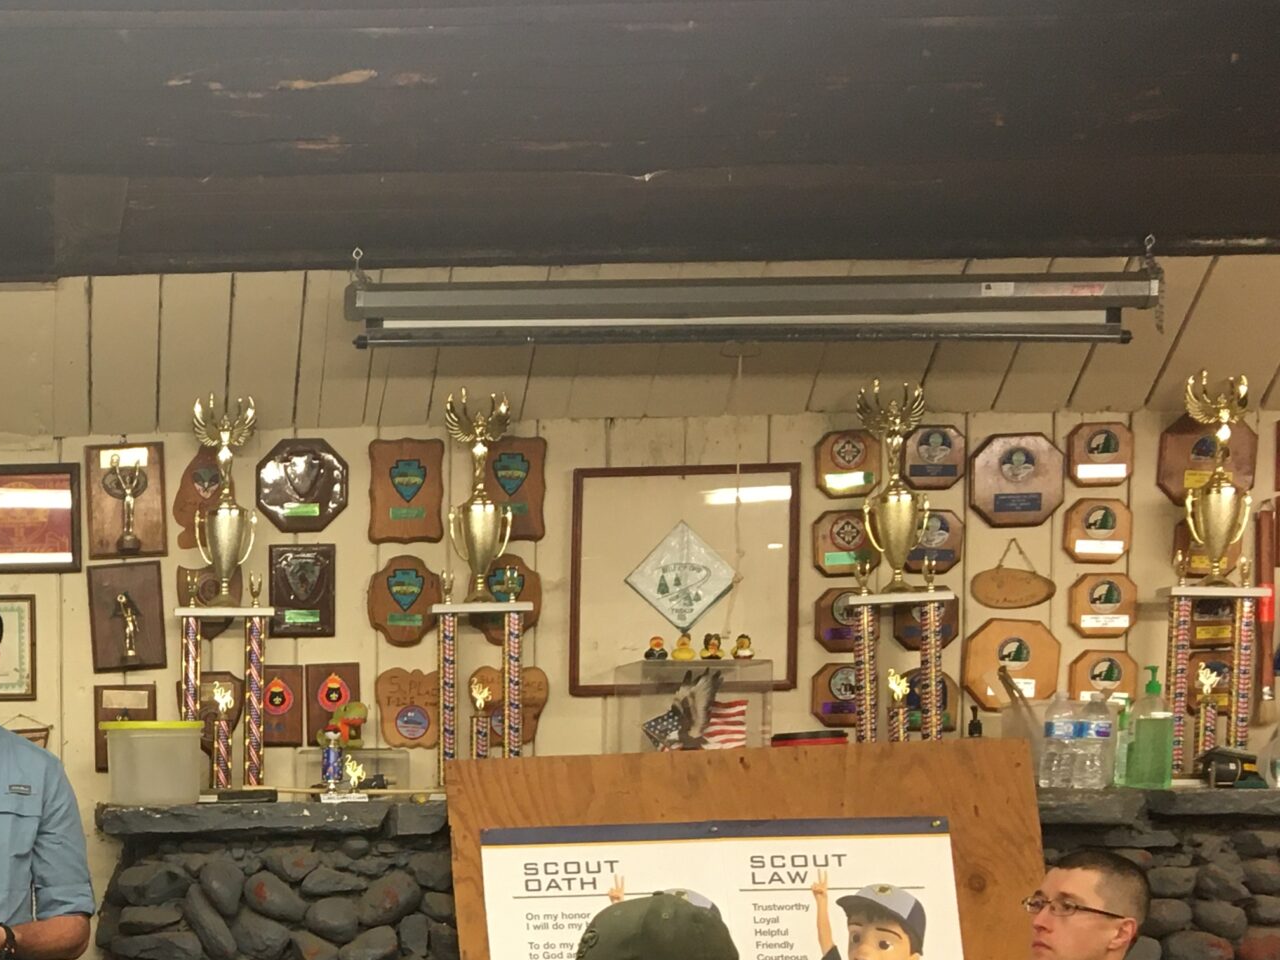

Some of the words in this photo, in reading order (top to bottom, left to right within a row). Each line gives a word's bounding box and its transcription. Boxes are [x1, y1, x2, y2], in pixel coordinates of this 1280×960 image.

[750, 854, 847, 868] SCOUT
[523, 860, 619, 876] SCOUT
[752, 870, 808, 885] LAW
[524, 877, 597, 892] OATH
[752, 902, 810, 912] Trustworthy
[525, 912, 540, 921] On
[543, 914, 558, 922] my
[561, 911, 591, 920] honor
[753, 915, 780, 925] Loyal
[532, 922, 549, 931] will
[552, 921, 565, 930] do
[567, 922, 583, 931] my
[754, 928, 789, 938] Helpful
[528, 941, 540, 950] To
[543, 941, 556, 950] do
[559, 942, 574, 951] my
[756, 941, 794, 951] Friendly
[529, 952, 539, 960] to
[542, 951, 564, 960] God
